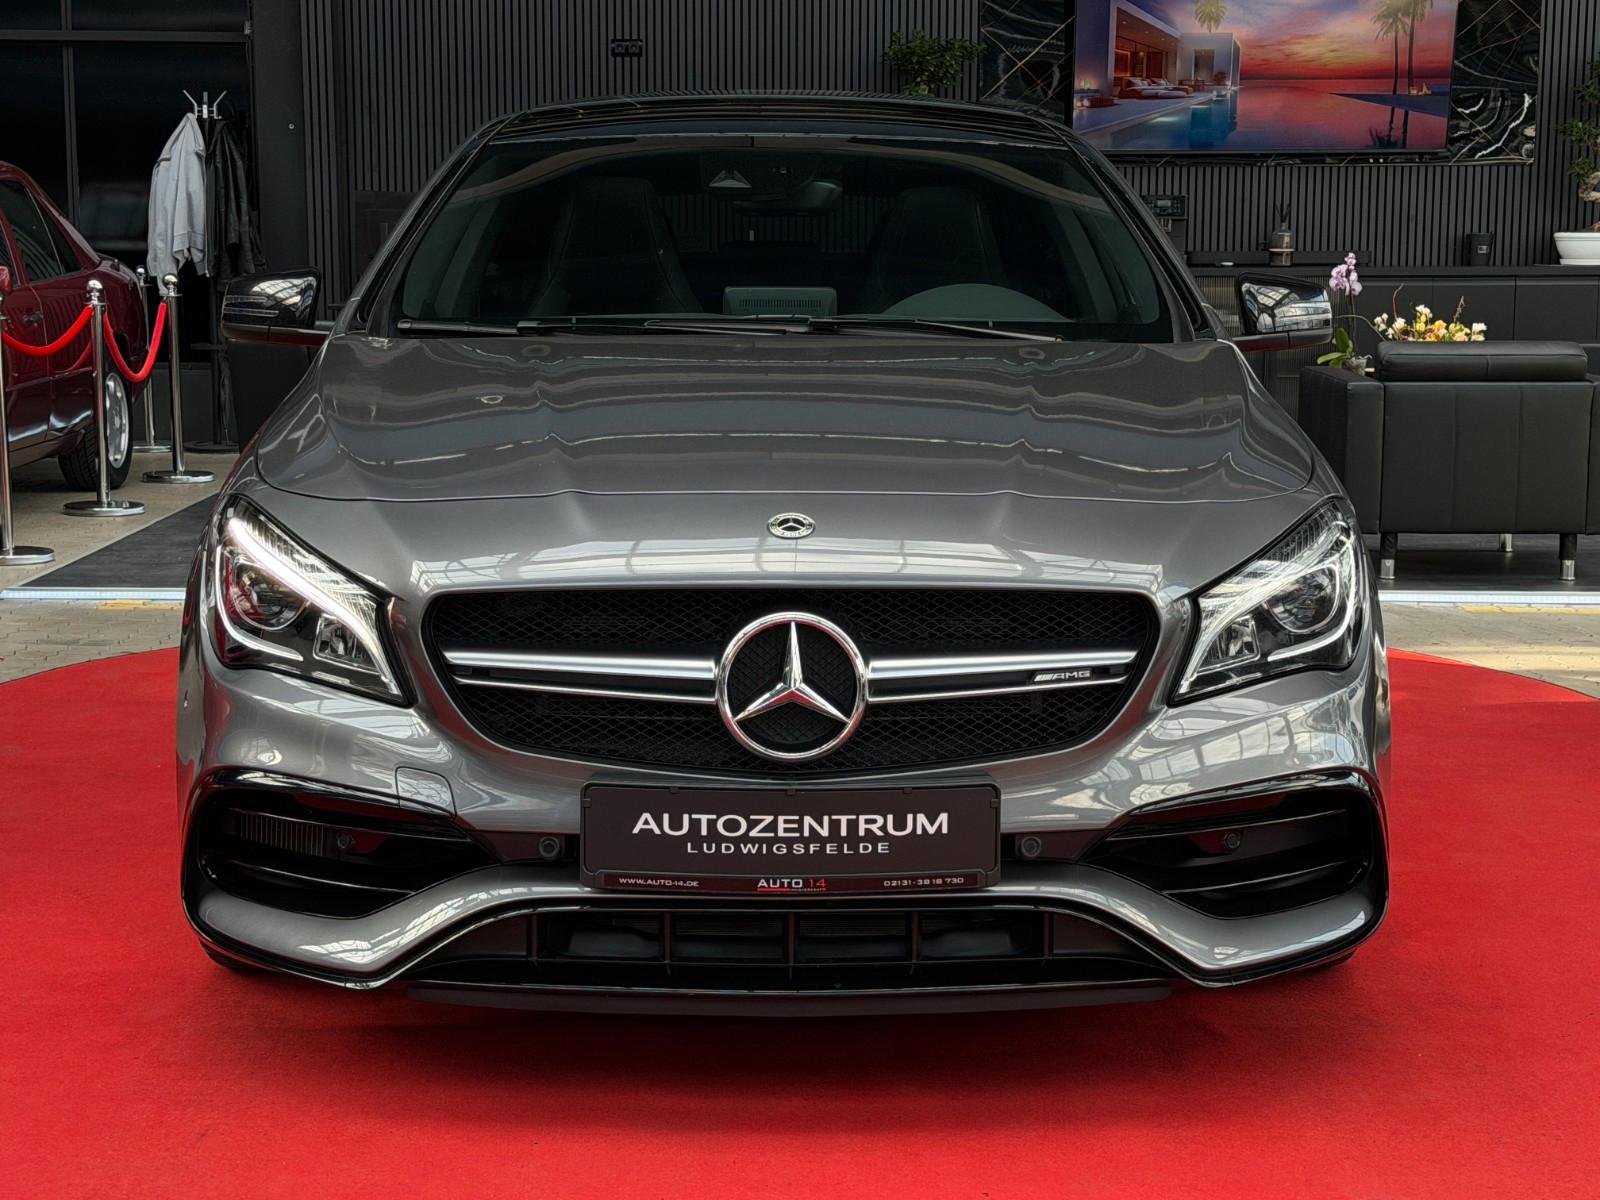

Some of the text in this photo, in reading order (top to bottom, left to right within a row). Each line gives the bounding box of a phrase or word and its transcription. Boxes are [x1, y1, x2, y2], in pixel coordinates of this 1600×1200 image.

[1052, 670, 1091, 680] AMG
[631, 812, 949, 837] AUTOZENTRUM
[687, 842, 890, 854] LUDWIGSFELDE
[757, 878, 826, 888] AUTO 14
